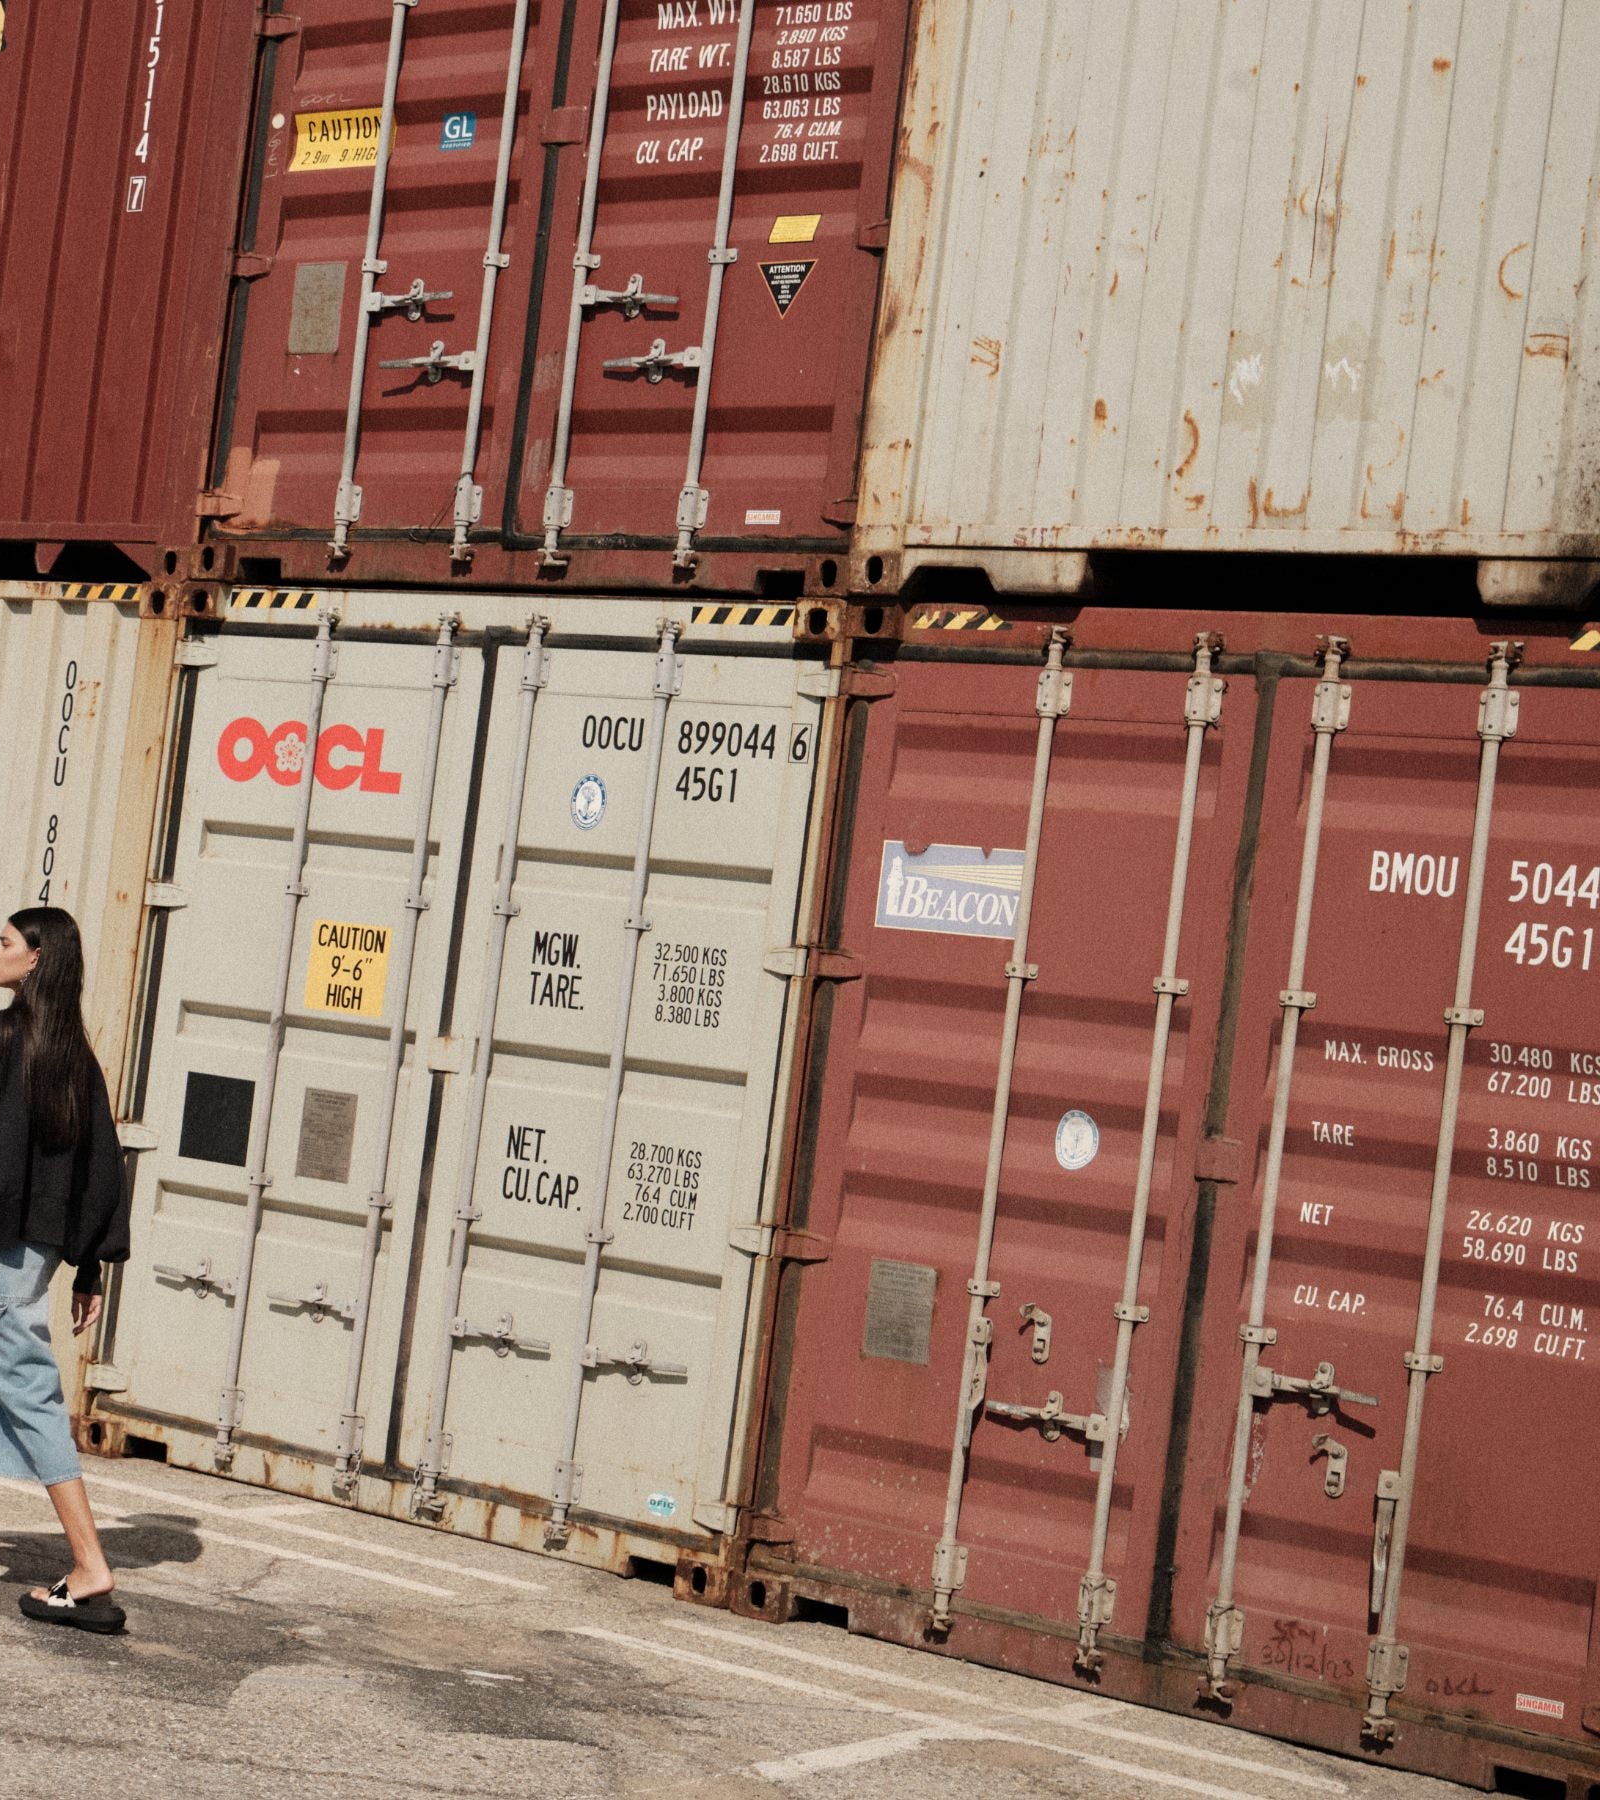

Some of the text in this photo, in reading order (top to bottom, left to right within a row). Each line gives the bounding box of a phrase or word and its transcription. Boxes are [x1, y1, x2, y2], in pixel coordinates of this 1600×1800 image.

[657, 0, 702, 30] MAX.
[776, 2, 853, 26] 71.650 LBS
[777, 26, 849, 45] 3.890 KGS
[649, 43, 731, 72] TARE WT.
[772, 46, 842, 69] 8.587 LBS
[763, 71, 841, 94] 28.610 KGS
[129, 0, 164, 211] 15114 7
[646, 90, 723, 121] PAYLOAD
[763, 97, 841, 119] 63.063 LBS
[444, 115, 472, 140] GL
[773, 123, 804, 139] 76.4
[636, 137, 703, 164] CU. CAP.
[759, 144, 797, 163] 2.698
[768, 264, 806, 274] ATTENTION
[54, 660, 77, 787] OOCU
[581, 714, 810, 762] OOCU 899044 6
[217, 716, 403, 795] OOCL
[675, 765, 738, 803] 45G1
[1368, 850, 1600, 910] BMOU 5044
[901, 875, 1020, 927] BEACON
[317, 923, 387, 954] CAUTION
[531, 930, 581, 969] MGW.
[1503, 921, 1594, 971] 45G1
[654, 942, 728, 967] 32.500 KGS
[652, 962, 726, 987] 71.650 LBS
[325, 983, 363, 1011] HIGH
[530, 971, 584, 1011] TARE.
[657, 984, 723, 1008] 3.800 KGS
[654, 1004, 720, 1029] 8.380 LBS
[1324, 1039, 1435, 1072] MAX. GROSS
[1570, 1052, 1600, 1076] KGS
[1567, 1080, 1600, 1106] LBS
[505, 1124, 548, 1164] NET.
[1311, 1120, 1355, 1147] TARE
[630, 1141, 703, 1170] 28.700 KGS
[1556, 1135, 1593, 1161] KGS
[627, 1162, 700, 1190] 63.270 LBS
[1555, 1165, 1591, 1189] LBS
[634, 1183, 698, 1211] 76.4 CU.M
[661, 1208, 695, 1232] CU.FT
[1299, 1201, 1335, 1227] NET
[1546, 1220, 1586, 1245] KGS
[1542, 1247, 1579, 1273] LBS
[1293, 1283, 1367, 1316] CU. CAP.
[1483, 1294, 1589, 1333] 76.4 CU.M.
[1533, 1332, 1587, 1361] CU.FT.
[649, 1498, 675, 1510] DFIC
[1517, 1696, 1563, 1715] SINGAMAS
